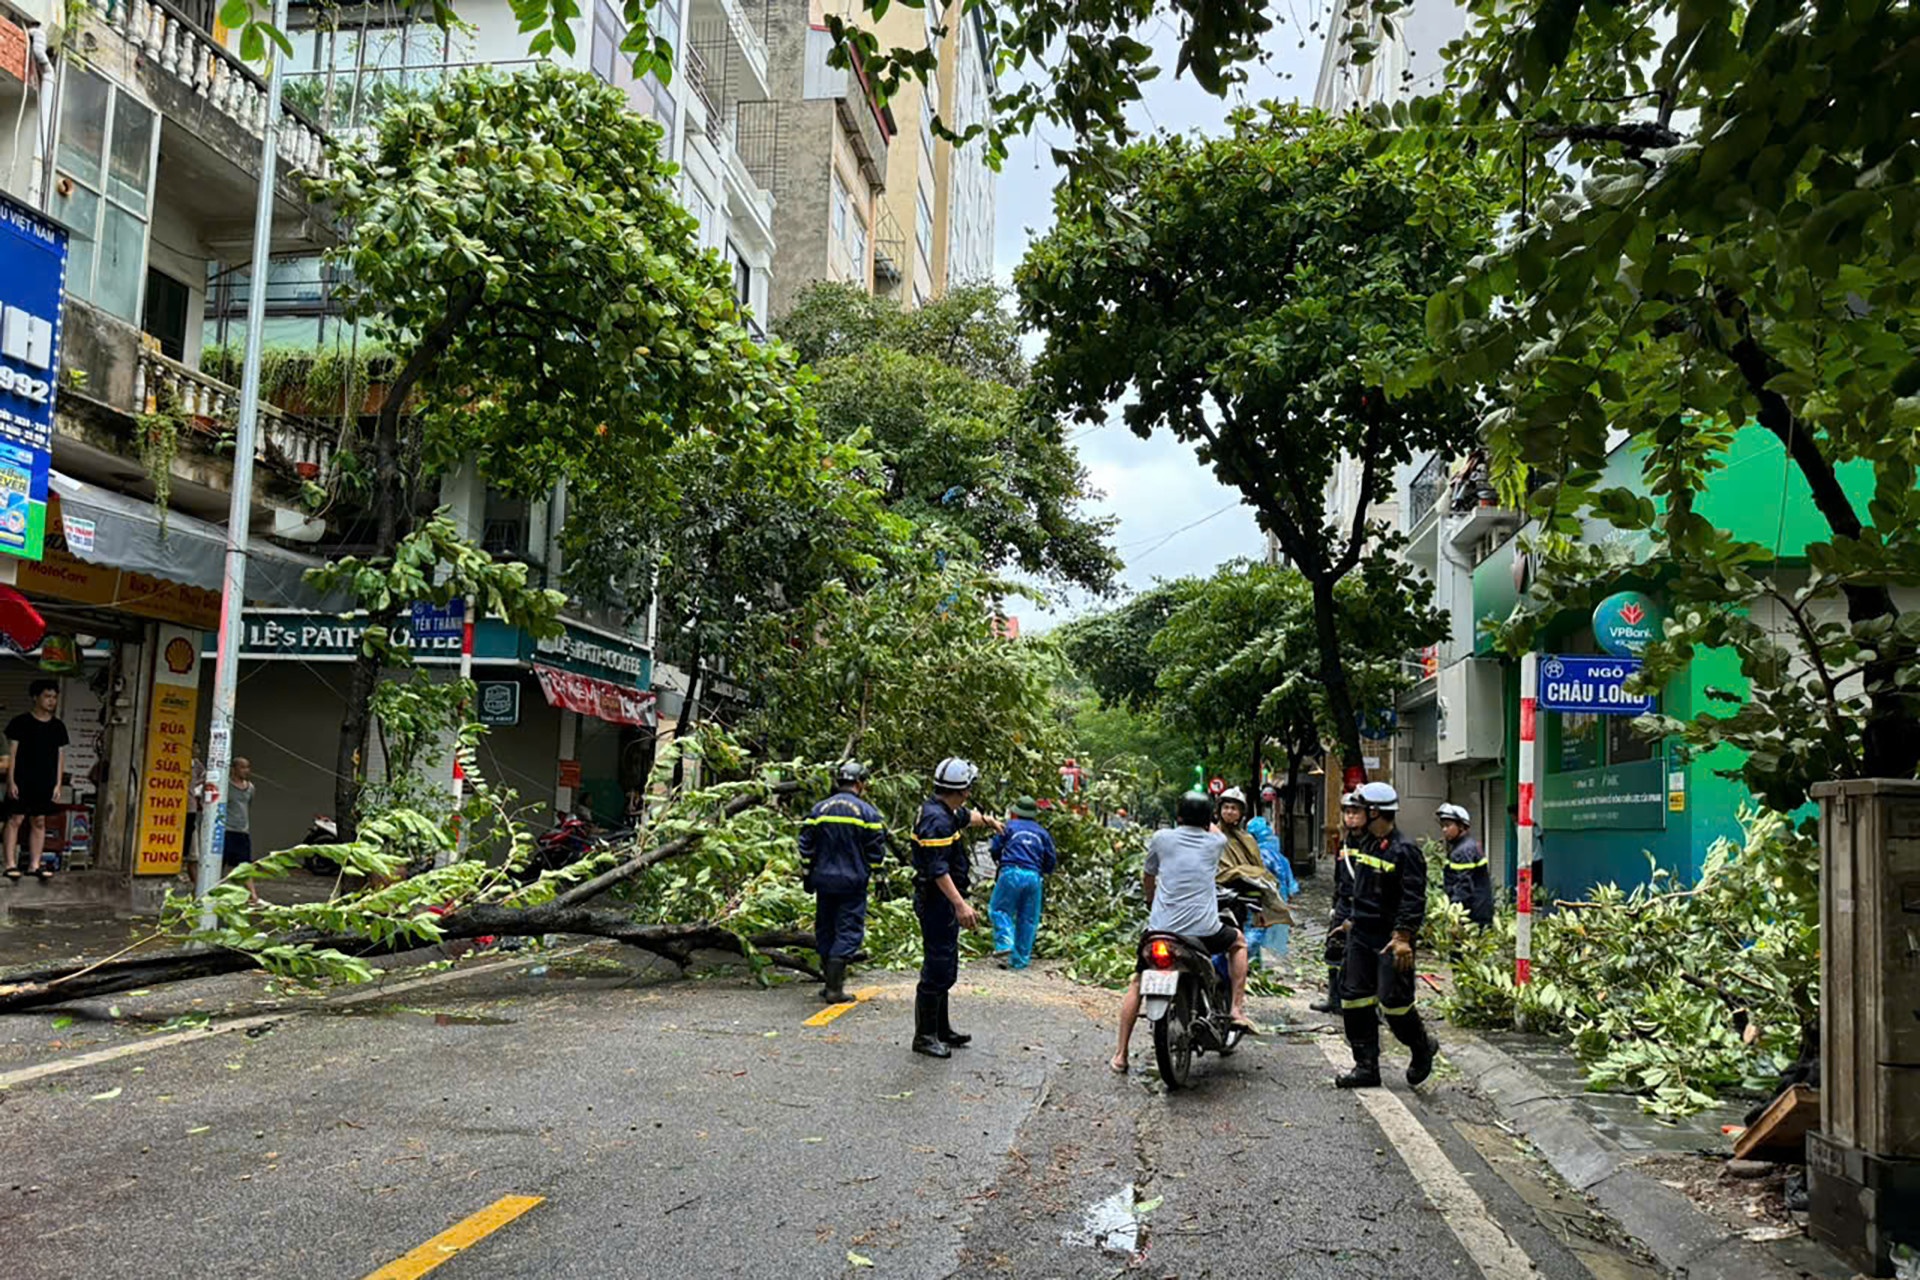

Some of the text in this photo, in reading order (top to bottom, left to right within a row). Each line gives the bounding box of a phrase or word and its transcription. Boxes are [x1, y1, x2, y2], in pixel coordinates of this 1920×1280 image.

[33, 223, 55, 245] NAM
[605, 649, 641, 676] COFFEE
[1547, 679, 1594, 702] CHÂU
[162, 742, 179, 754] XE
[150, 797, 182, 808] THAY
